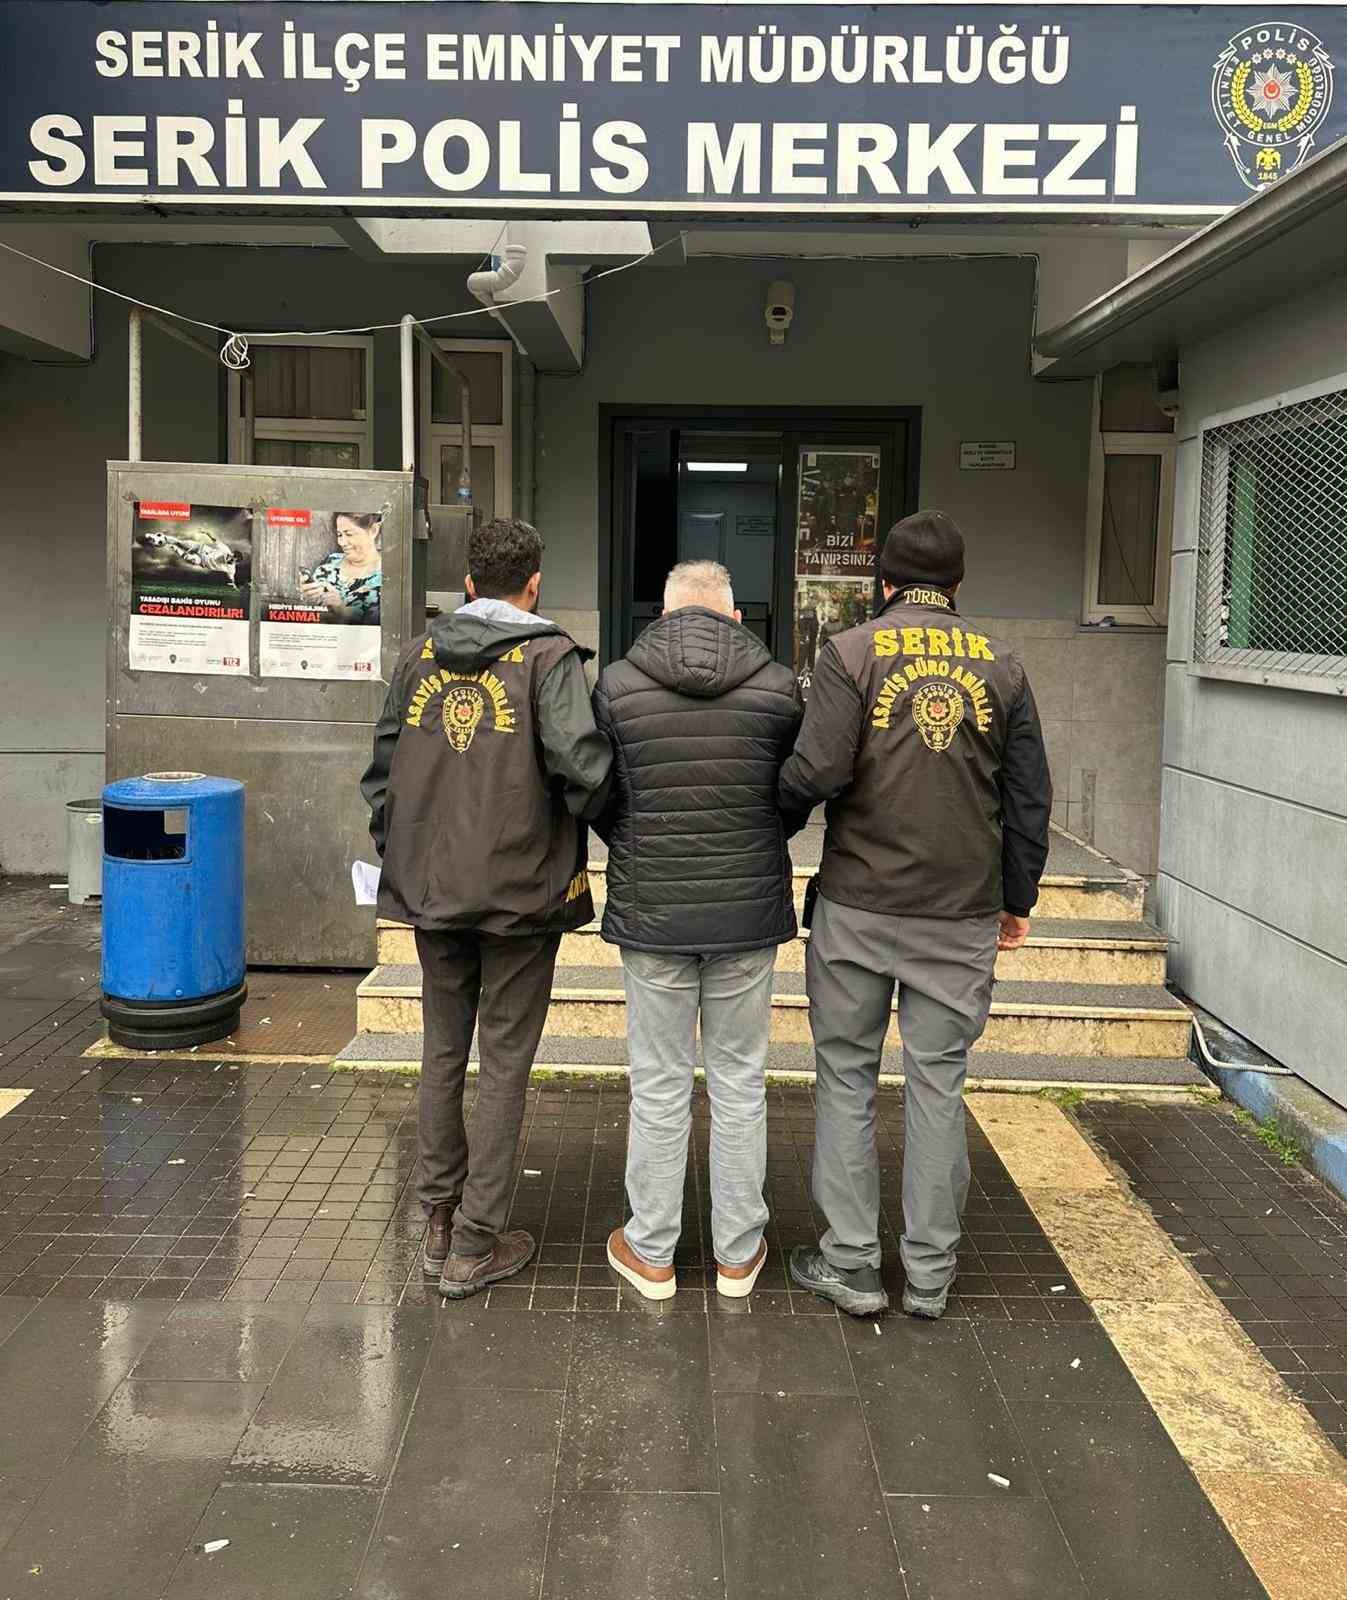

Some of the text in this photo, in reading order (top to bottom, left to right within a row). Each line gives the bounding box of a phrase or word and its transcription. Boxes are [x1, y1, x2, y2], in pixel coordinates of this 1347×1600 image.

[1240, 28, 1310, 51] POLİS
[95, 20, 1070, 93] SERİK İLÇE EMNİYET MÜDÜRLÜĞÜ
[28, 98, 1139, 196] SERİK POLİS MERKEZİ
[1248, 131, 1292, 143] GENEL
[826, 531, 855, 547] BİZİ
[803, 552, 876, 567] TANIRSINIZ
[140, 604, 244, 618] CEZALANDIRILIR!
[269, 611, 320, 622] KANMA!
[873, 627, 995, 661] SERİK
[406, 674, 442, 727] ASAYİŞ
[872, 673, 909, 728] ASAYİŞ
[904, 657, 949, 681] BÜRO
